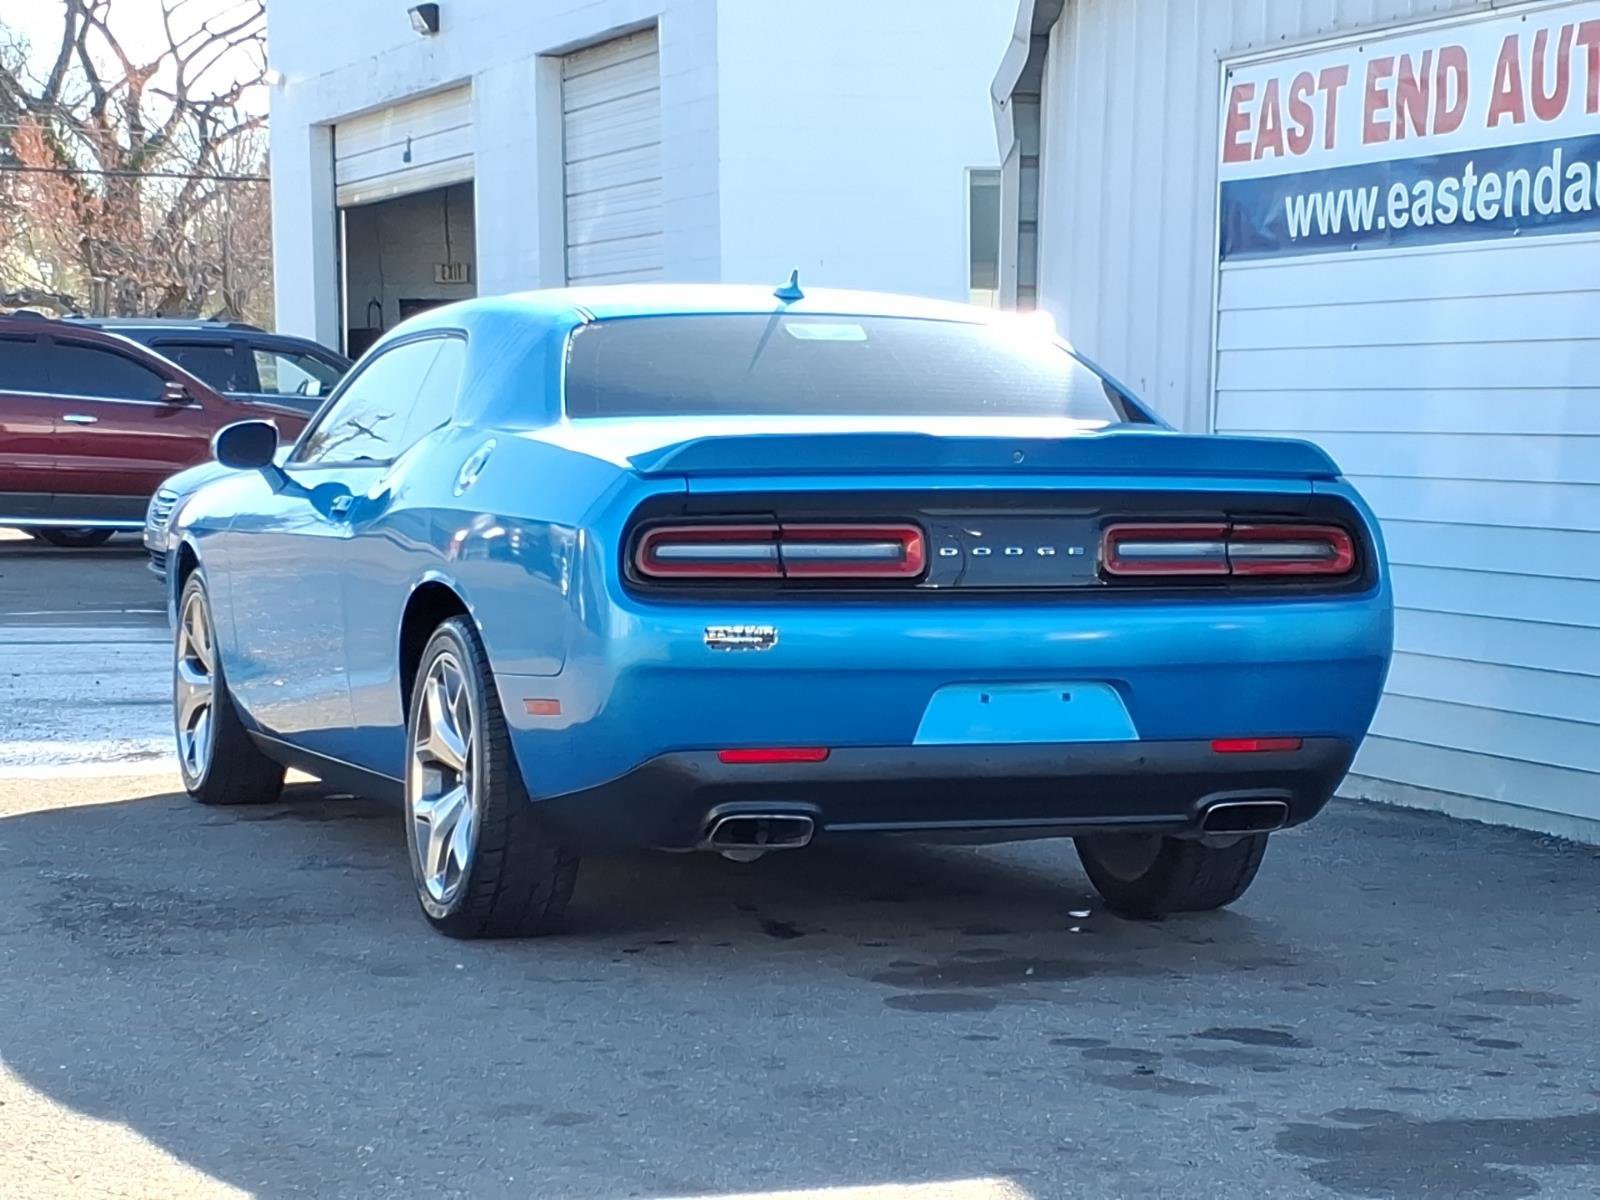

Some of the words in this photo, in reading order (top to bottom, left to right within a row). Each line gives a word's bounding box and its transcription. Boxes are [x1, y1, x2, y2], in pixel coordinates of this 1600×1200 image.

[1223, 65, 1349, 163] EAST
[1363, 45, 1469, 144] END
[1285, 147, 1600, 238] www.eastenda
[441, 263, 465, 281] EXIT
[939, 547, 1085, 557] DODGE
